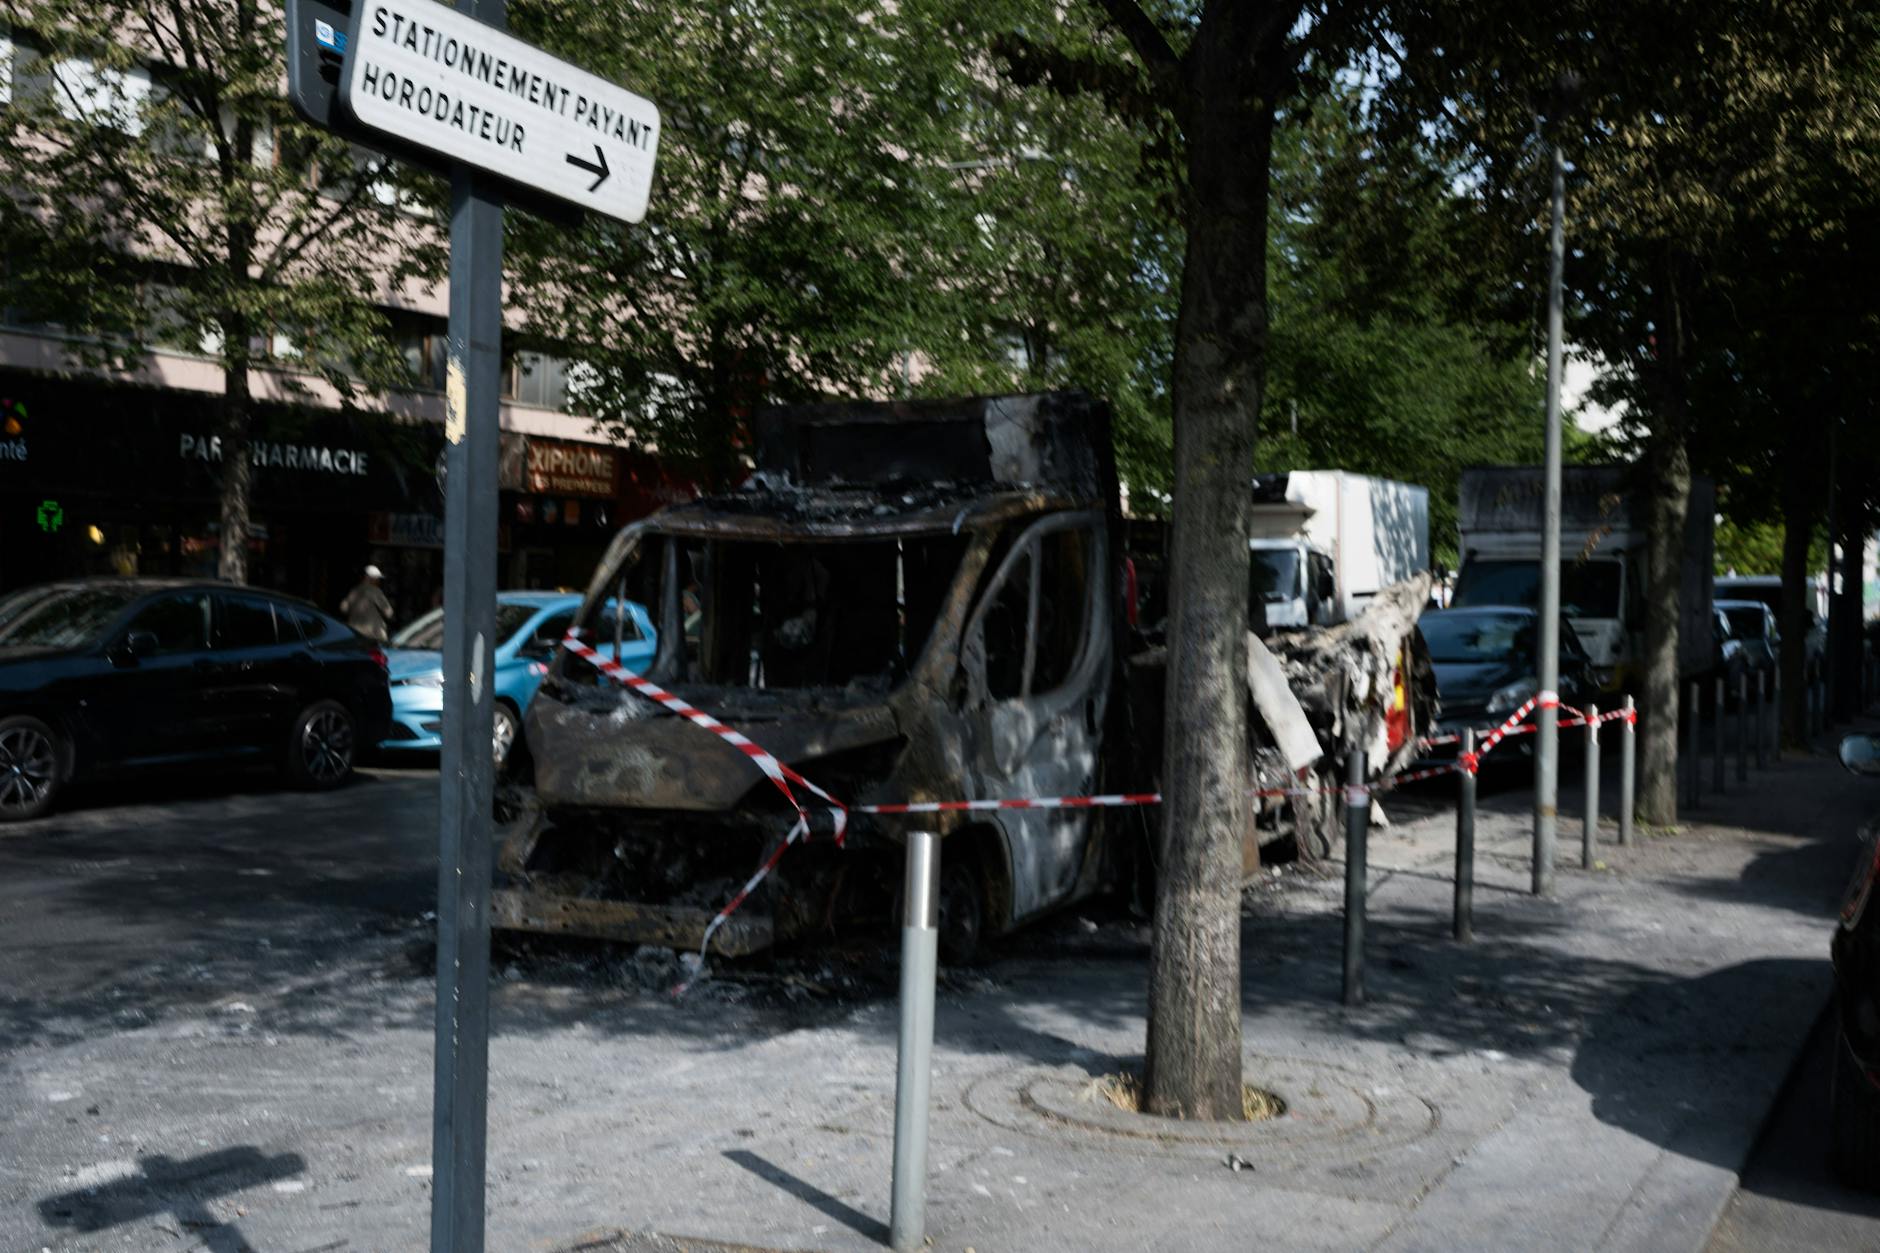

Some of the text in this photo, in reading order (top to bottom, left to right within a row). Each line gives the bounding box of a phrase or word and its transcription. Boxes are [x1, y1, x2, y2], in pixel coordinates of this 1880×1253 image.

[363, 63, 525, 153] HORODATEUR
[373, 8, 652, 150] STATIONNEMENT PAYANT
[180, 434, 368, 475] PARHARMACIE
[528, 446, 613, 478] XIPHONE
